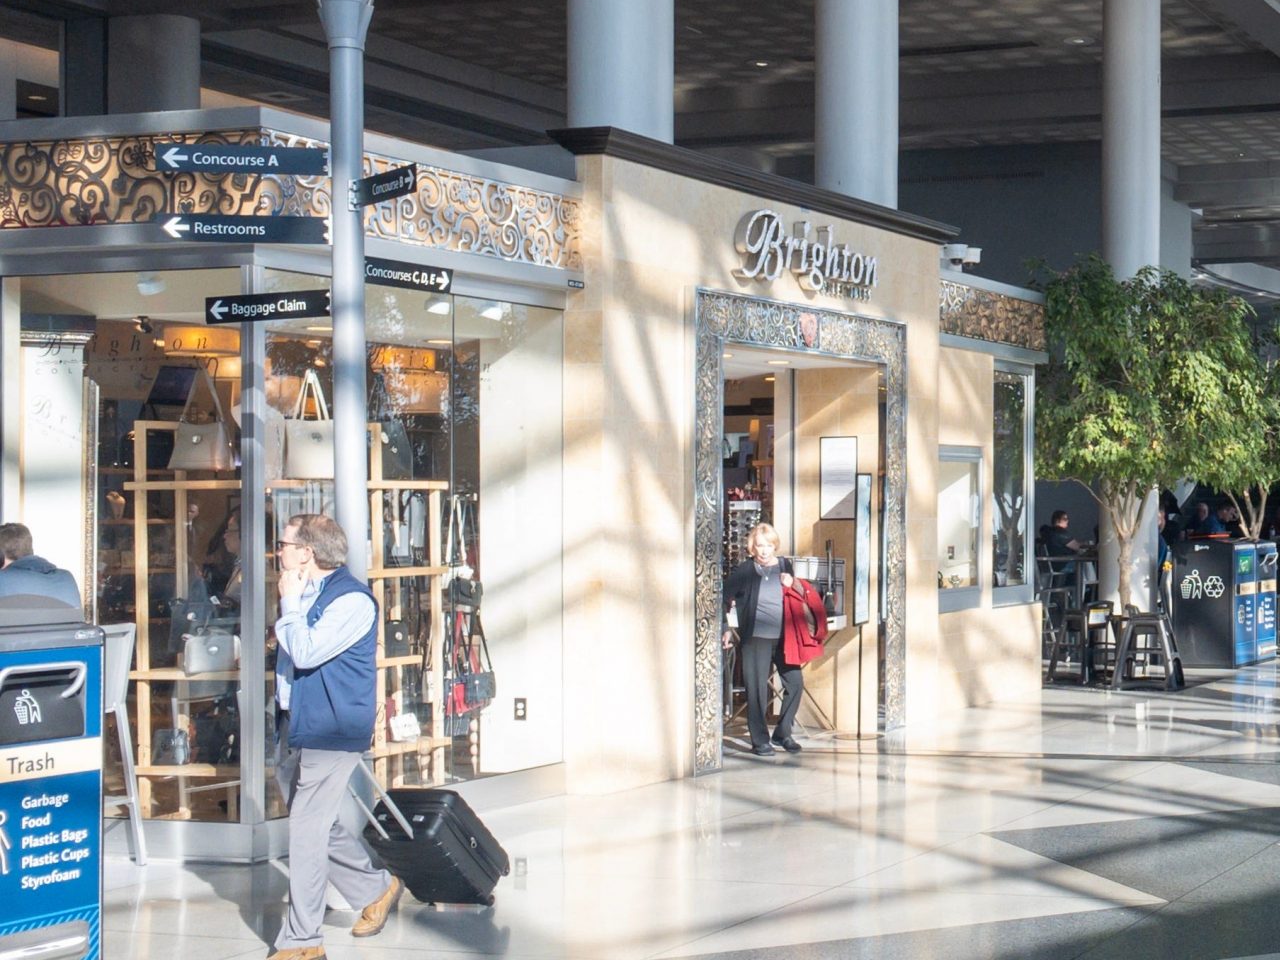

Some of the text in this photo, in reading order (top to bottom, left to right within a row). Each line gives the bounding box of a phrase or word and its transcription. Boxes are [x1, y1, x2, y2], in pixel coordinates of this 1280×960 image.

[192, 152, 279, 167] Concourse A
[371, 179, 399, 196] Concourse
[194, 221, 266, 236] Restrooms
[741, 209, 879, 290] Brighton
[366, 264, 412, 282] Concourses
[231, 299, 307, 317] Baggage Claim
[6, 751, 55, 775] Trash
[21, 793, 70, 810] Garbage
[21, 812, 52, 830] Food
[21, 828, 88, 850] Plastic Bags
[21, 847, 90, 870] Plastic Cups
[21, 868, 81, 890] Styrofoam
